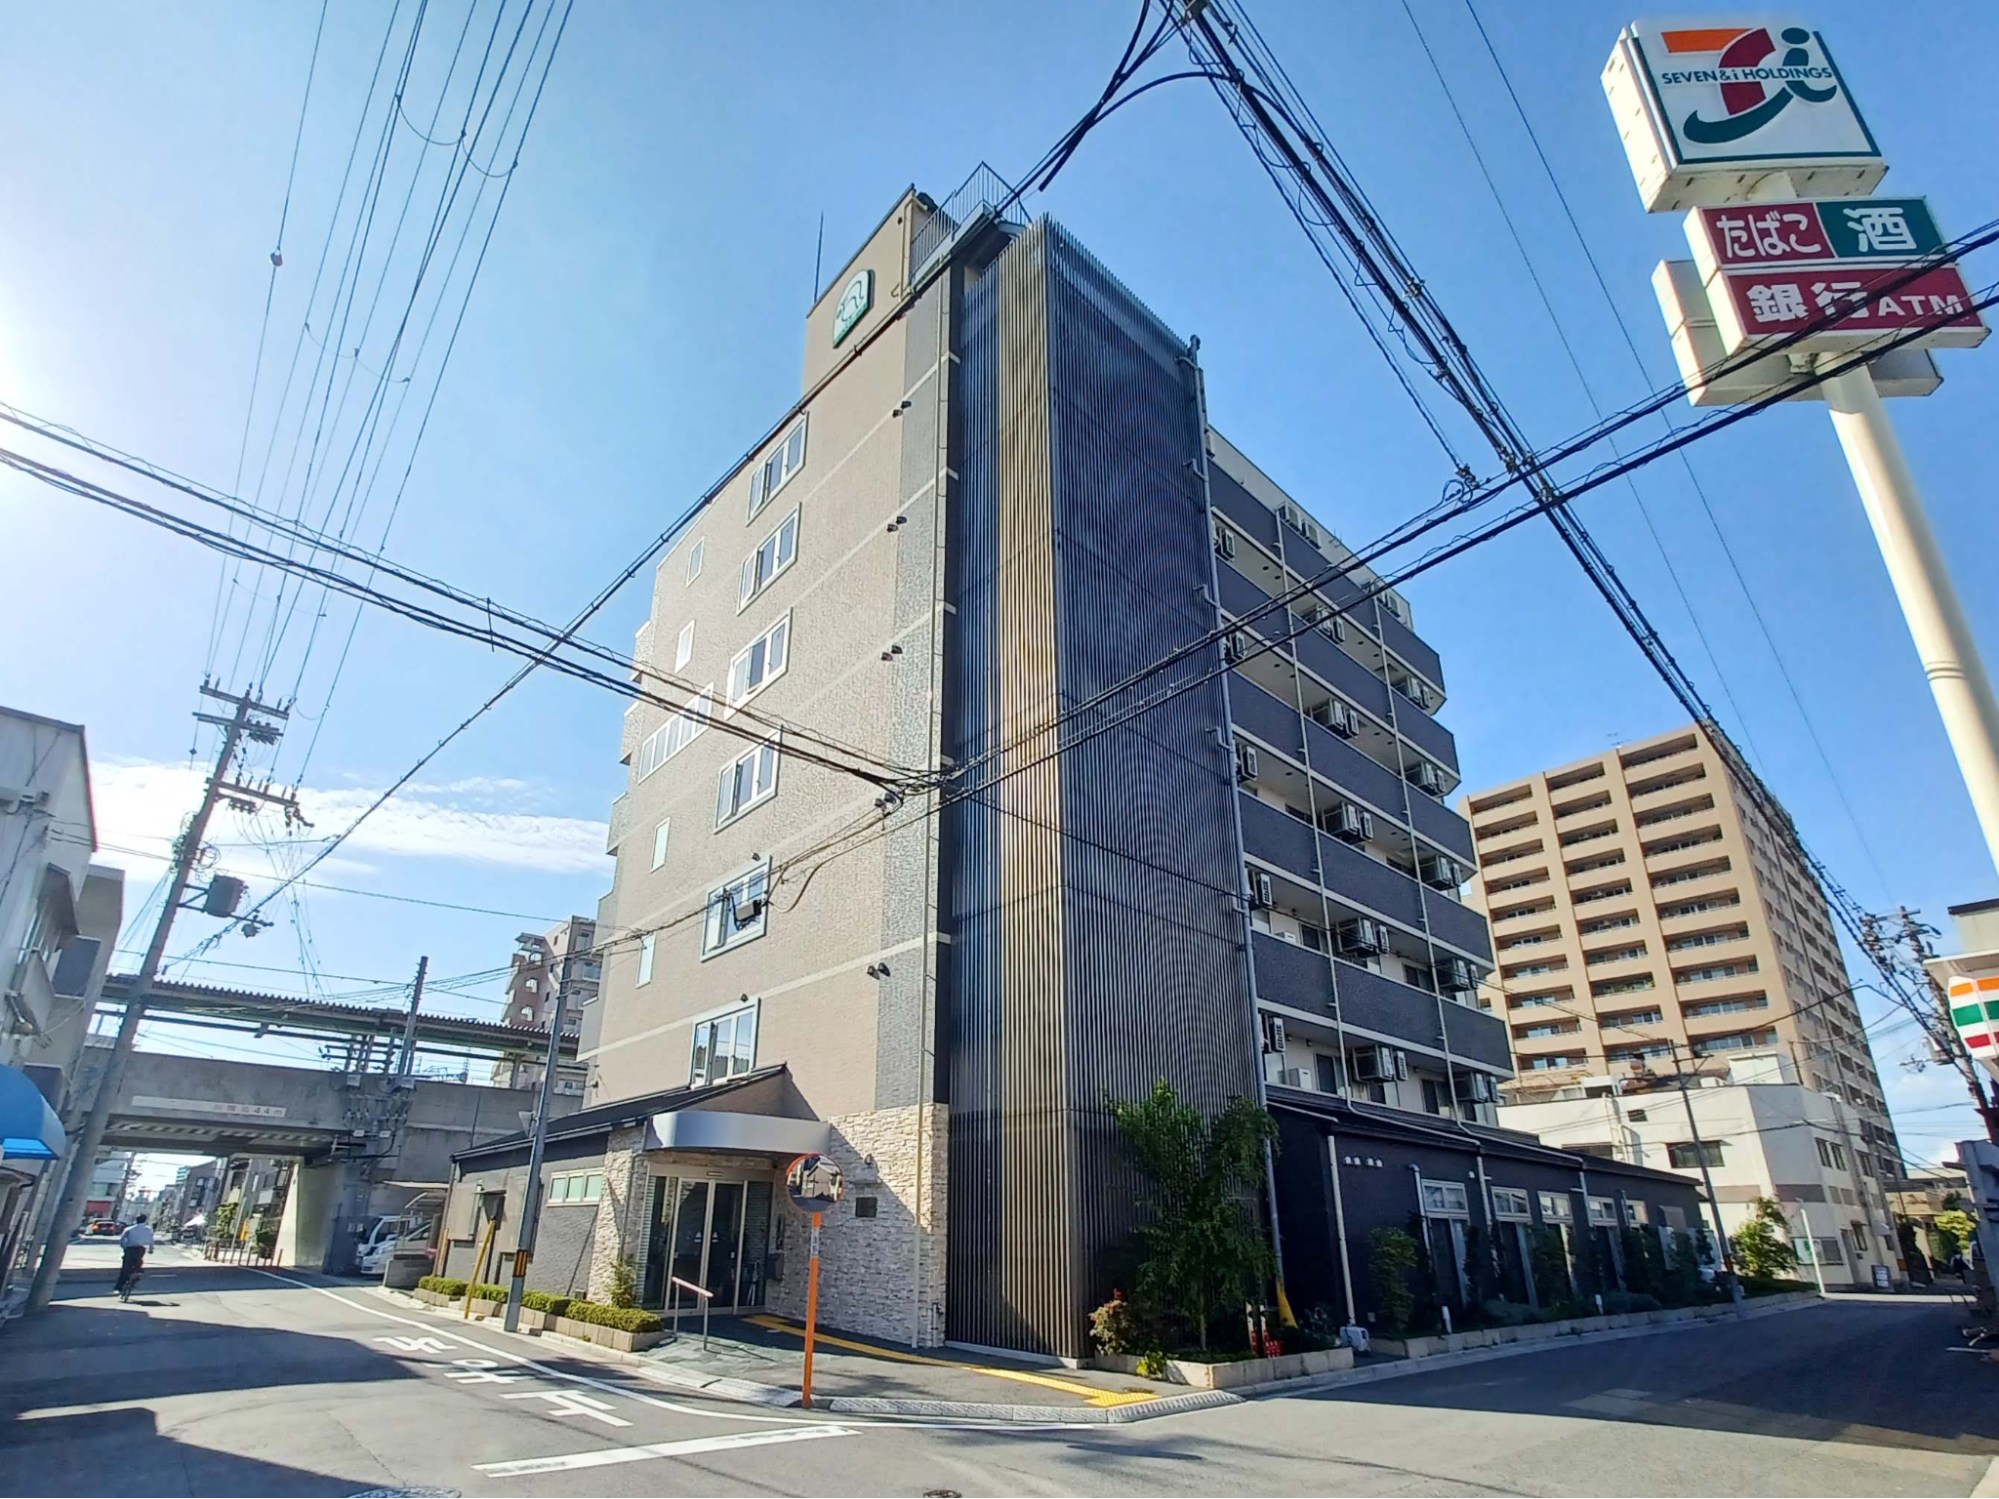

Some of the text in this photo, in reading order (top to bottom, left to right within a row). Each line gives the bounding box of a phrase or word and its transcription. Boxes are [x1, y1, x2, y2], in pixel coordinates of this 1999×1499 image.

[1744, 67, 1833, 82] HOLDINGS
[1716, 209, 1821, 258] たばこ
[1843, 207, 1917, 252] 酒
[1746, 282, 1965, 322] 銀行 ATM
